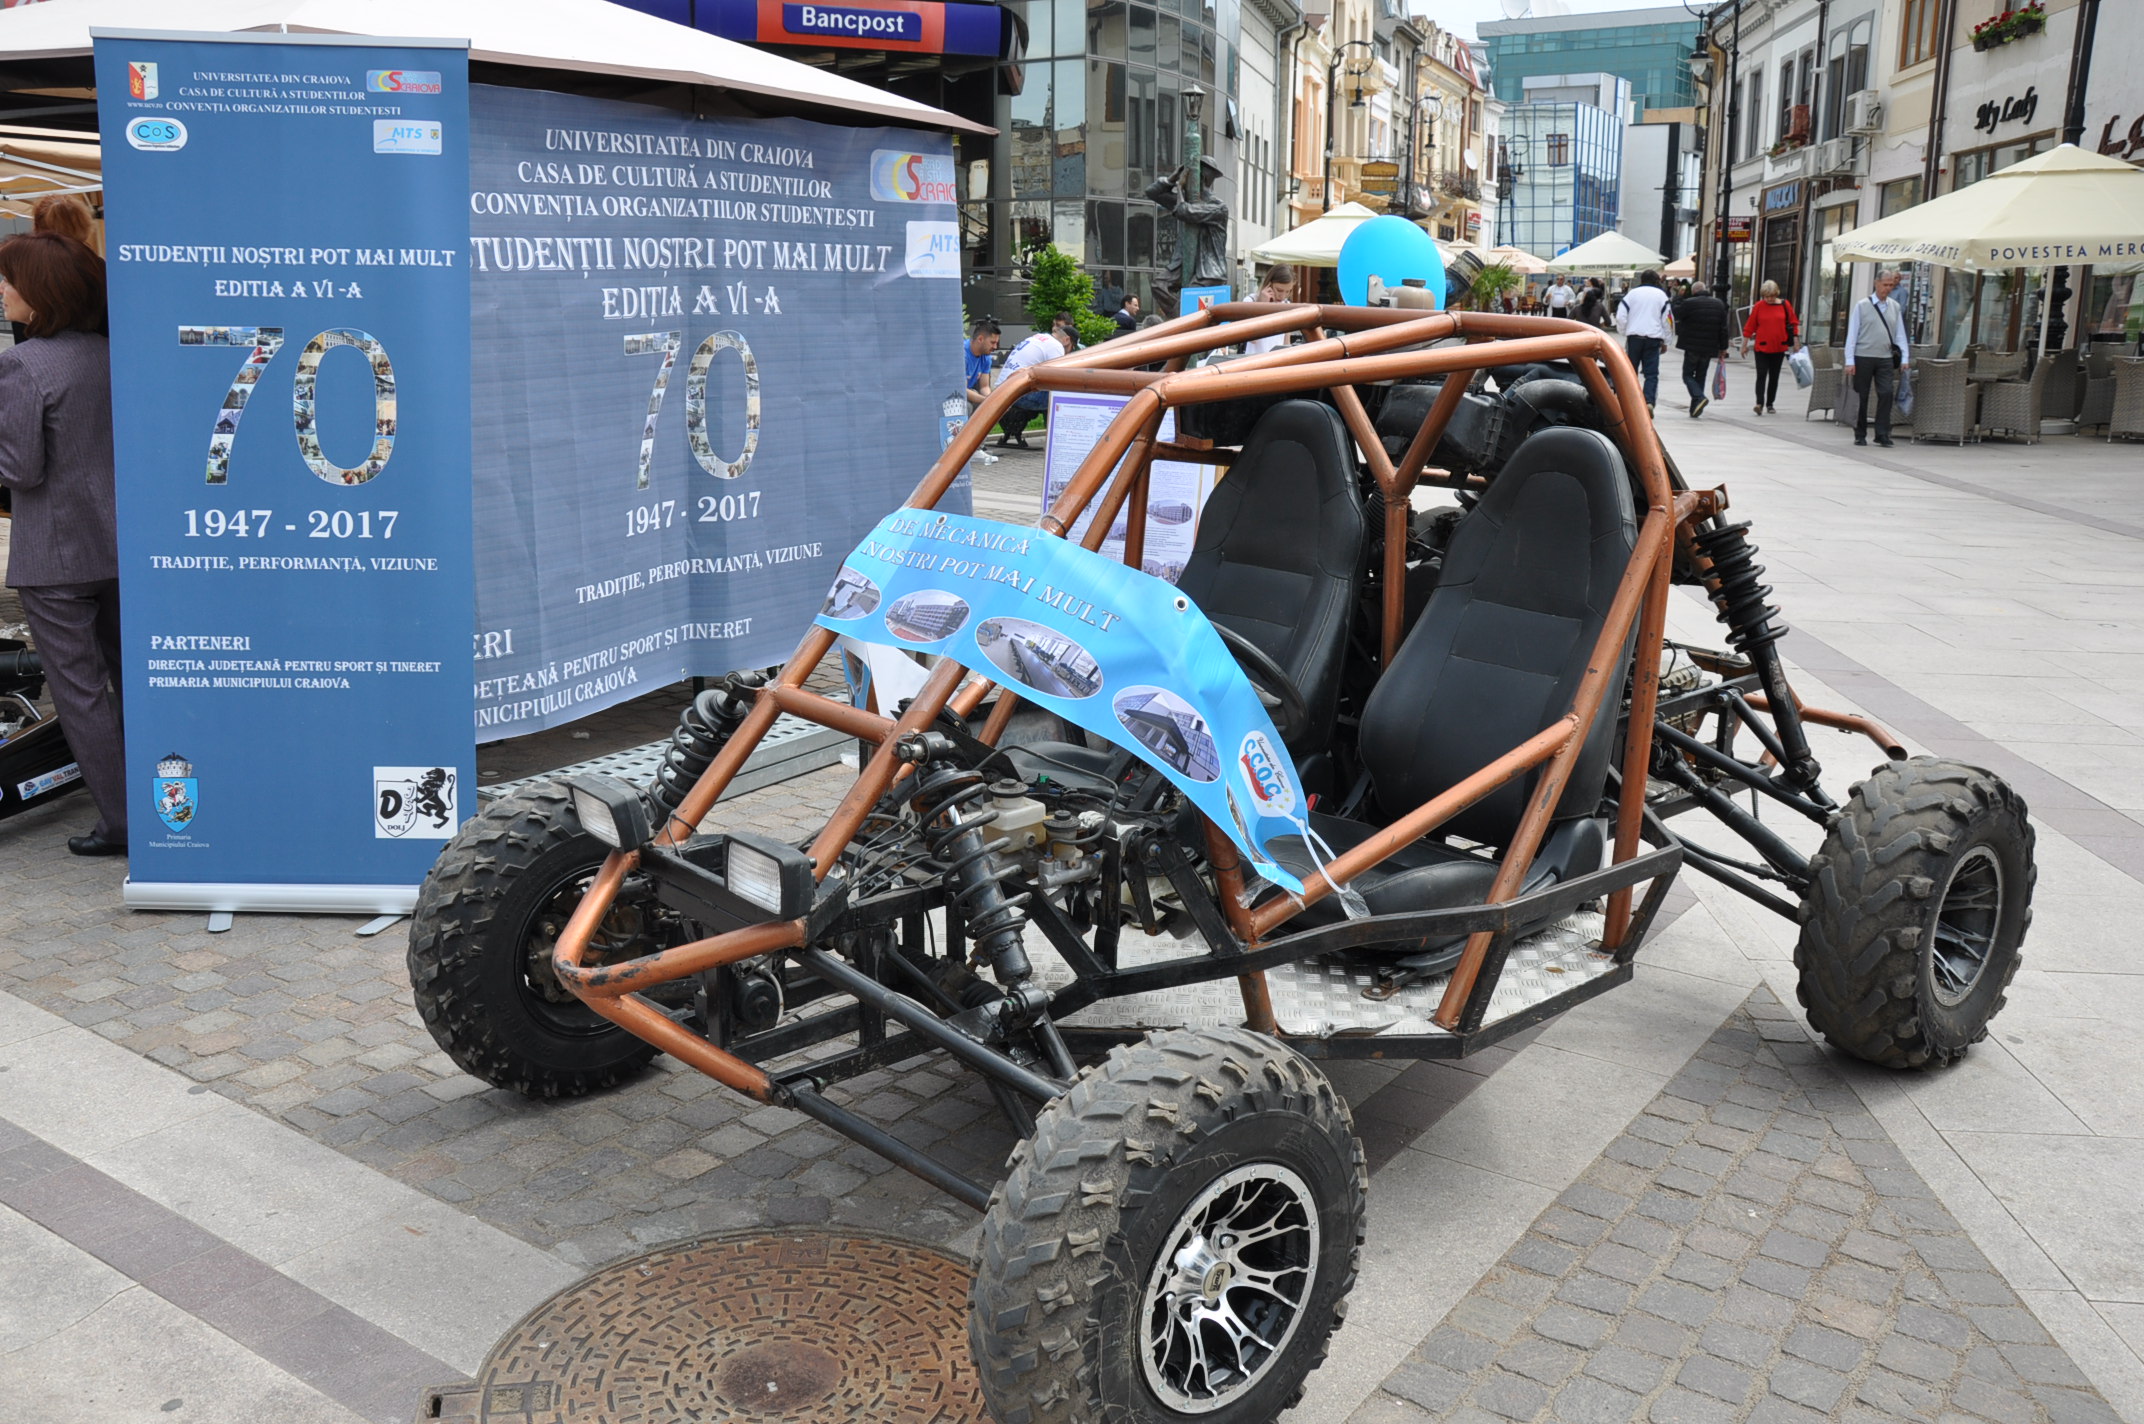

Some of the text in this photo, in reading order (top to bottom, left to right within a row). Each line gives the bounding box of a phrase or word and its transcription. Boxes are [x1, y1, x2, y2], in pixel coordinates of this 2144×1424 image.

[802, 7, 904, 35] Bancpost
[179, 86, 208, 97] CASA
[210, 88, 225, 97] DE
[280, 90, 287, 99] A
[193, 72, 351, 85] UNIVERSITATEA DIN CRAIOVA
[166, 101, 231, 114] CONVENȚIA
[1974, 86, 2038, 134] My Lady
[392, 127, 422, 139] MTS
[545, 128, 814, 169] UNIVERSITATEA DIN CRAIOVA
[517, 161, 575, 185] CASA
[578, 165, 605, 186] DE
[611, 163, 699, 189] CULTURĂ
[703, 170, 718, 189] A
[471, 191, 599, 222] CONVENȚIA
[602, 197, 758, 223] ORGANIZAȚIILOR
[118, 245, 456, 268] STUDENȚII NOȘTRI POT MAI MULT
[469, 237, 893, 279] TUDENȚII NOȘTRI POT MAI MULT
[1916, 242, 1959, 260] DEPARTE
[1990, 245, 2088, 261] POVESTEA
[290, 280, 308, 298] A
[312, 279, 334, 299] VI
[338, 281, 364, 299] -A
[602, 280, 782, 326] EDIȚIA A VI -A
[178, 325, 397, 486] 70
[623, 330, 761, 490] 70
[183, 508, 273, 538] 1947
[307, 510, 399, 540] 2017
[625, 500, 675, 538] 1947
[697, 491, 761, 523] 2017
[887, 518, 919, 536] DE
[917, 522, 1030, 556] MECANICA
[150, 555, 439, 573] TRADIȚIE, PERFORMANȚĂ, VIZIUNE
[575, 542, 823, 605] TRADIȚIE, PERFORMANȚĂ, VIZIUNE
[860, 540, 1121, 633] NOSTRI POT MAI MULT
[150, 635, 251, 651] PARTENERI
[563, 646, 618, 680] PENTRU
[619, 631, 662, 661] SPORT
[664, 627, 678, 650] ȘI
[681, 618, 753, 641] TINERET
[148, 659, 206, 673] DIRECȚIA
[284, 660, 332, 672] PENTRU
[334, 660, 374, 672] SPORT
[390, 661, 441, 673] TINERET
[148, 676, 351, 689] PRIMARIA MUNICIPIULUI CRAIOVA
[574, 665, 639, 702] CRAIOVA
[387, 824, 406, 832] DOLJ
